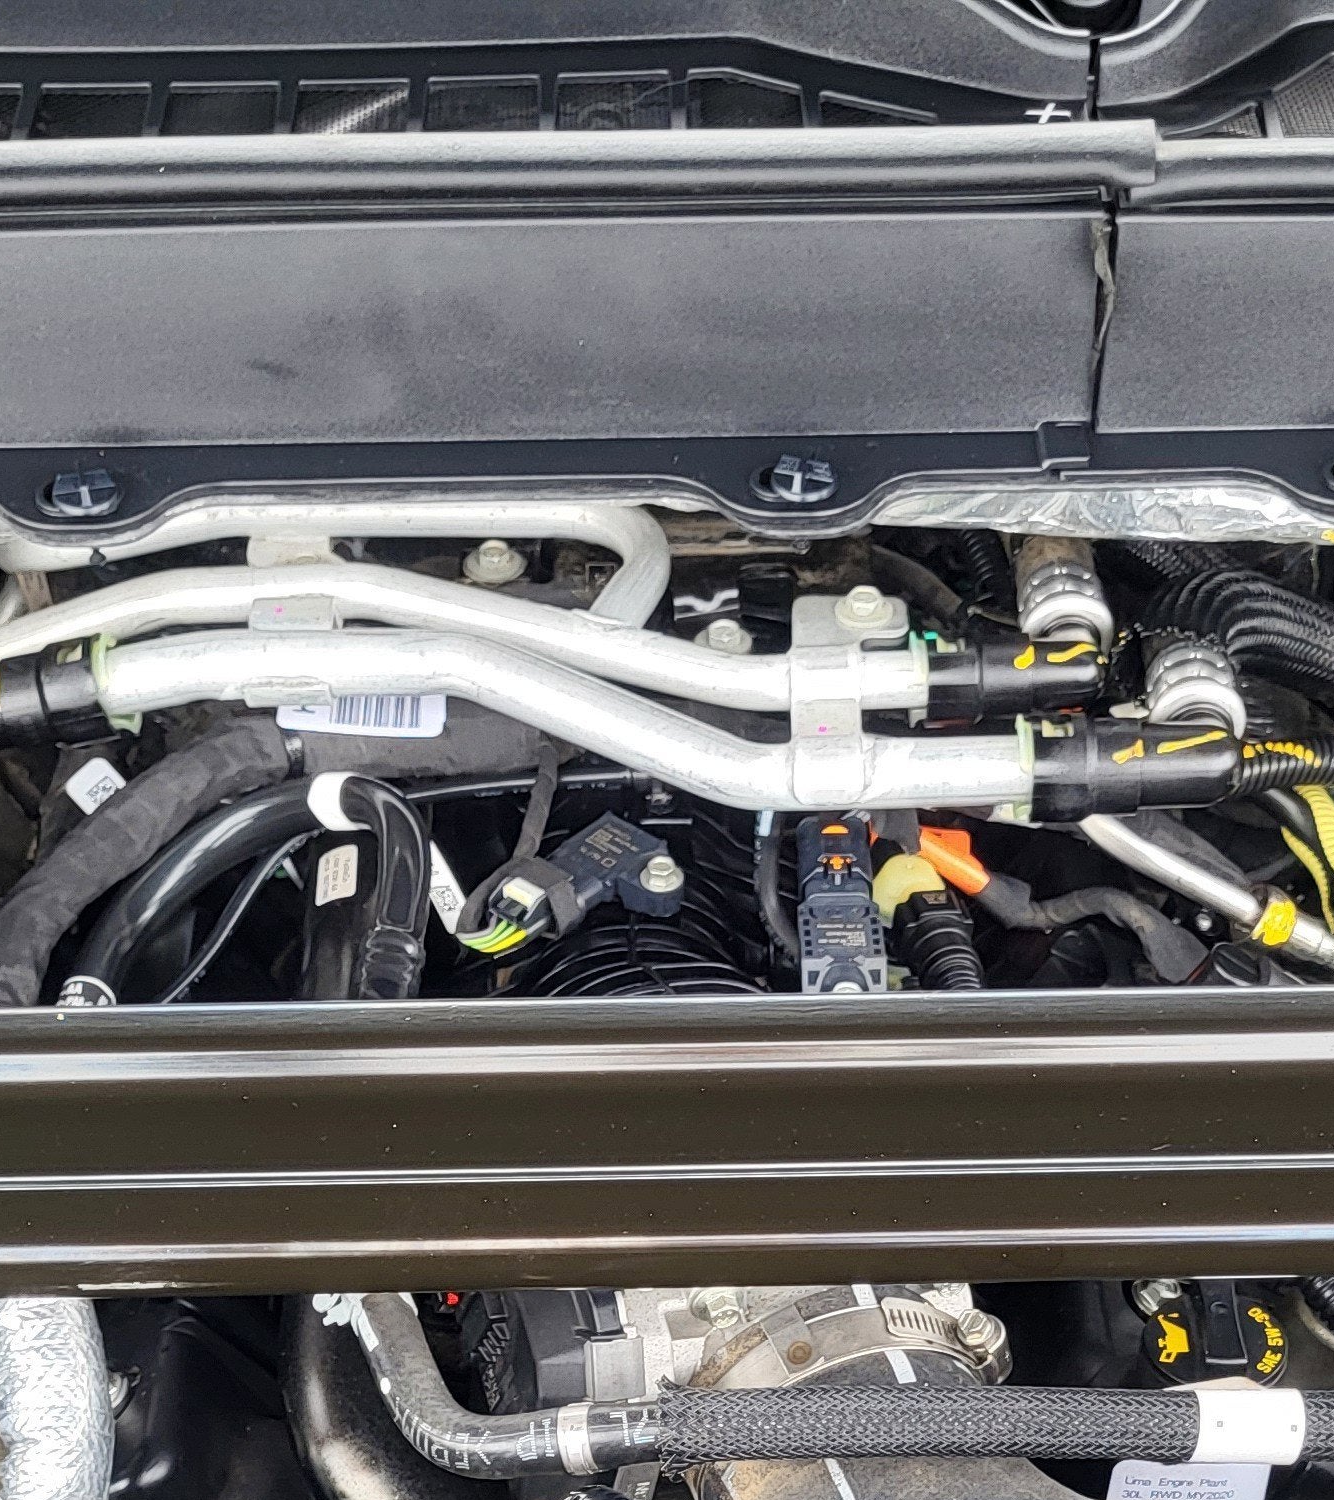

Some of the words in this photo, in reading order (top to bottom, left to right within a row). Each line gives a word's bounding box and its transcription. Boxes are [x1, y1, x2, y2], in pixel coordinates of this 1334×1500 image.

[1247, 1307, 1284, 1347] 5W-30
[1256, 1350, 1283, 1373] SAE
[1124, 1476, 1152, 1487] Lima
[1158, 1478, 1194, 1488] Engine
[1199, 1479, 1229, 1488] Plant
[1149, 1490, 1183, 1499] RWD
[1186, 1489, 1235, 1500] MY2020
